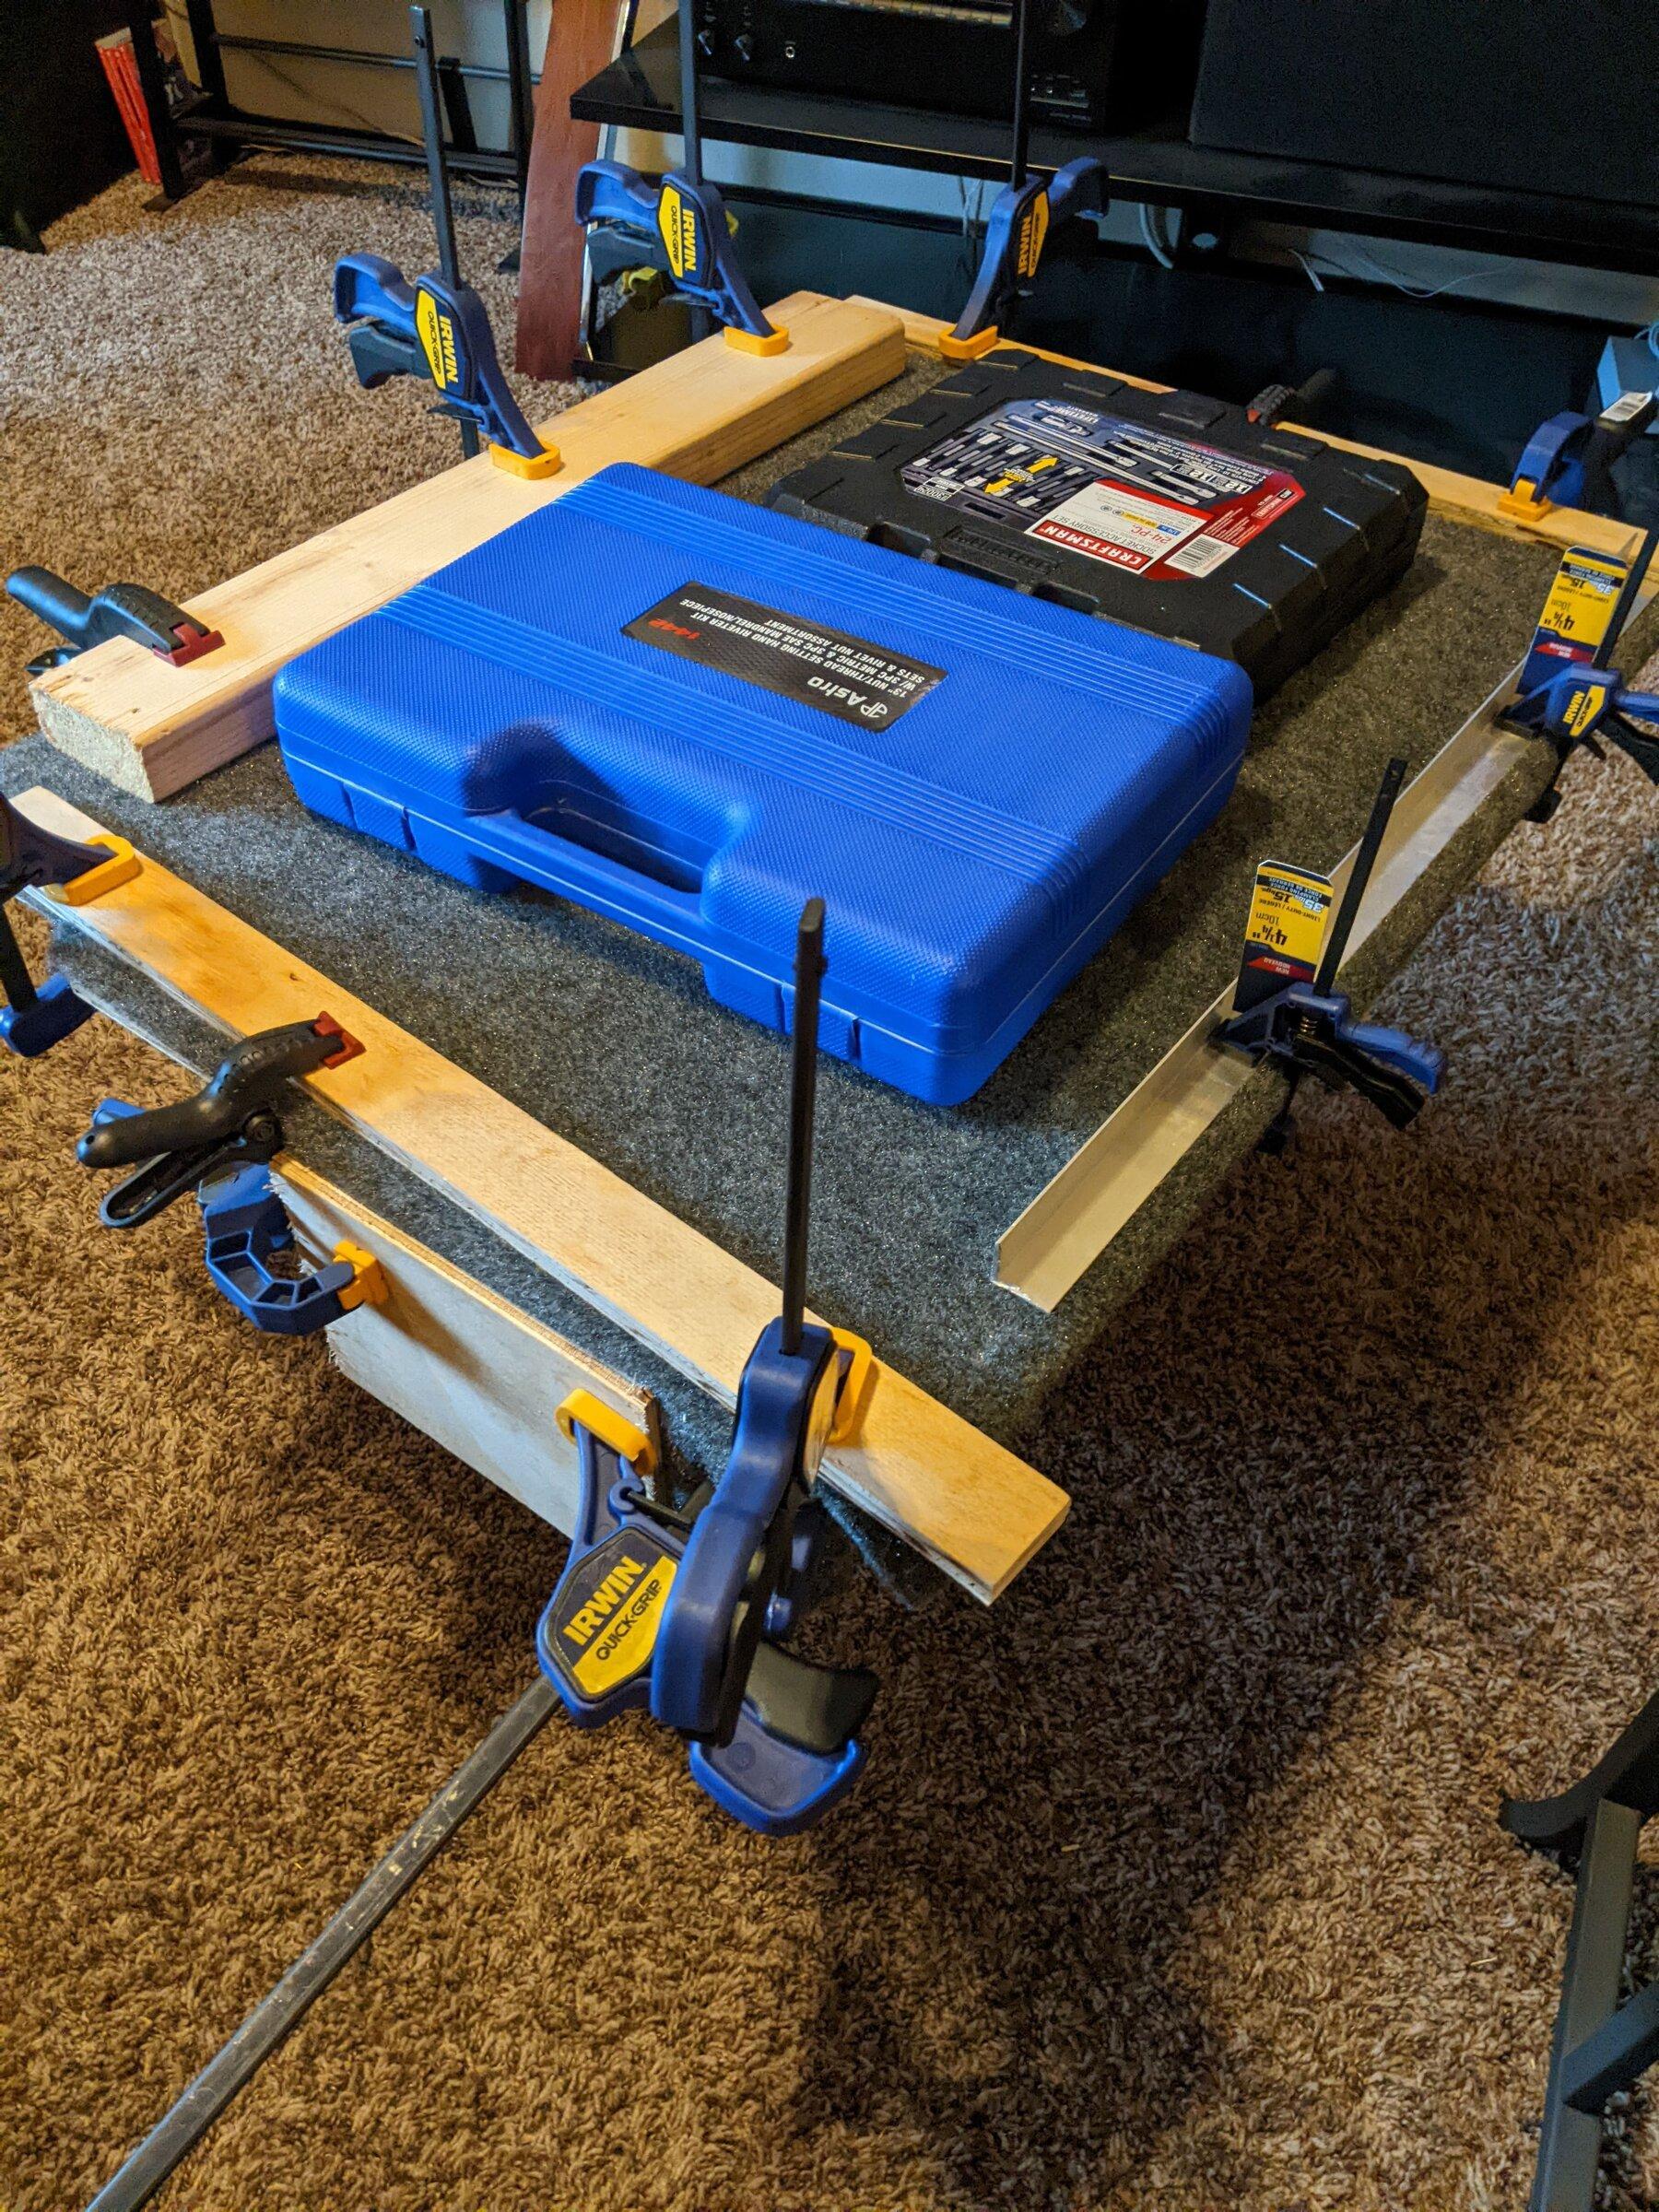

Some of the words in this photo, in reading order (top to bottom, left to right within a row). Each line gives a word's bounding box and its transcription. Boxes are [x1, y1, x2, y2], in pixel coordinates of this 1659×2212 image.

[682, 208, 697, 272] IRWIN
[1018, 215, 1032, 275] IRWIN
[439, 314, 459, 383] IRWIN
[1188, 468, 1211, 481] 12
[1224, 479, 1247, 492] 12
[1050, 513, 1071, 524] SET
[1067, 520, 1123, 542] ACCESSORY
[1041, 524, 1145, 565] CRAFTSMAN
[1117, 537, 1158, 554] SOCKET
[678, 597, 782, 639] MANDREL/NOSEPIECE
[688, 611, 710, 621] KIT
[646, 617, 702, 641] 1442
[706, 617, 752, 637] RIVETER
[762, 618, 833, 647] ASSORTMENT
[748, 632, 781, 647] HAND
[780, 634, 804, 646] SAE
[801, 642, 827, 654] 3PC
[830, 642, 854, 654] NUT
[778, 643, 825, 664] SETTING
[852, 651, 888, 667] RIVET
[834, 654, 879, 674] METRIC
[820, 660, 890, 689] NUT/THREAD
[876, 670, 901, 683] 3PC
[895, 668, 926, 682] SETS
[898, 678, 918, 689] W/
[801, 676, 868, 707] Astro
[1562, 690, 1585, 724] IRWIN
[1254, 911, 1279, 925] 10cm
[562, 1555, 645, 1646] IRWIN
